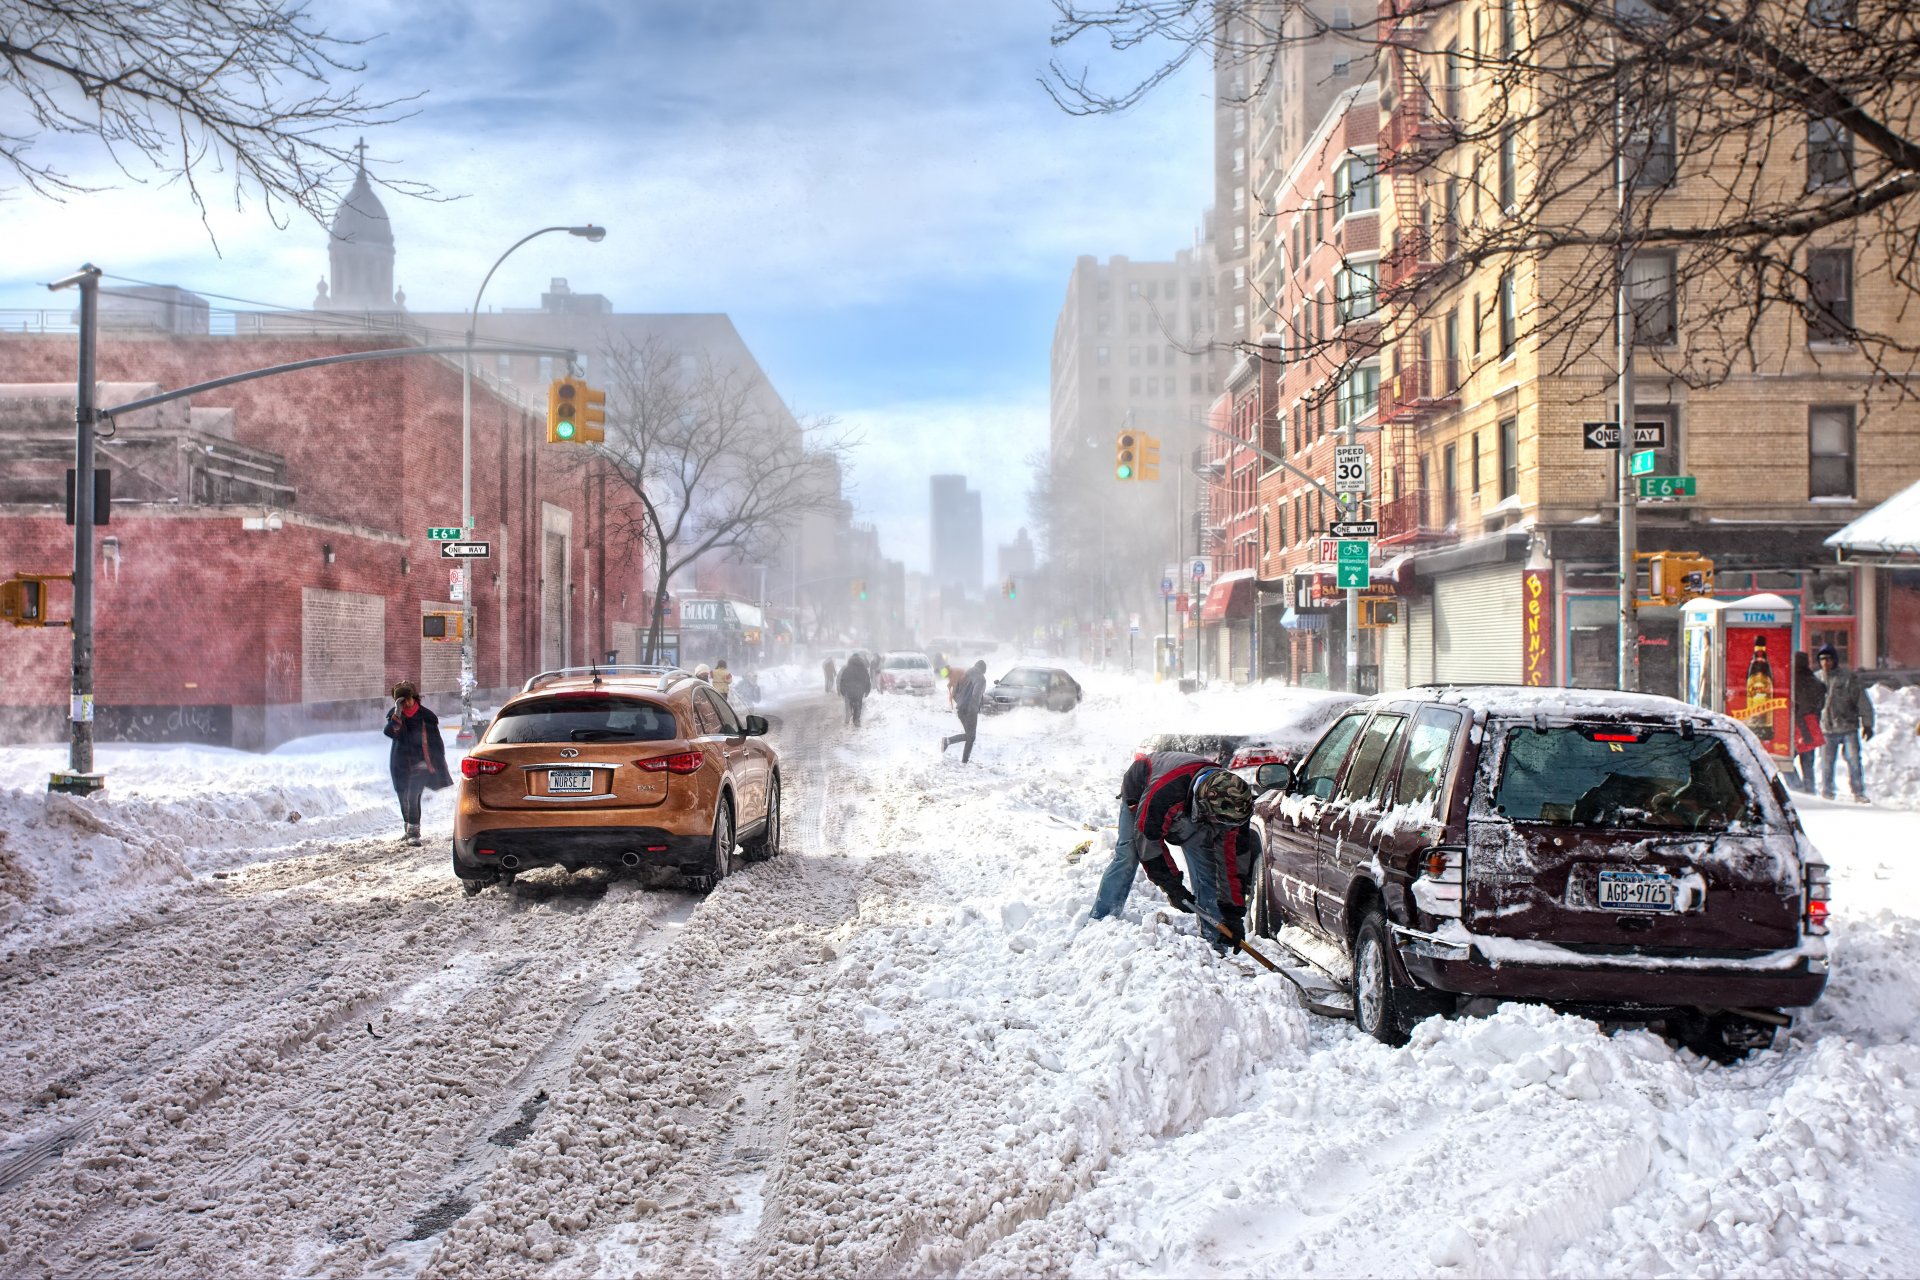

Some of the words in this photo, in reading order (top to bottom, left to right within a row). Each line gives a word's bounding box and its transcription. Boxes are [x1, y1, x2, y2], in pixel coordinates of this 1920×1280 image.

[1596, 430, 1619, 441] ONE
[1338, 464, 1362, 479] 30
[1646, 480, 1656, 495] E
[1661, 480, 1671, 495] 6
[1675, 479, 1686, 487] ST
[432, 529, 439, 539] E
[441, 529, 448, 539] 6
[1743, 613, 1775, 622] TITAN
[554, 776, 578, 788] NURSE
[581, 776, 587, 788] P
